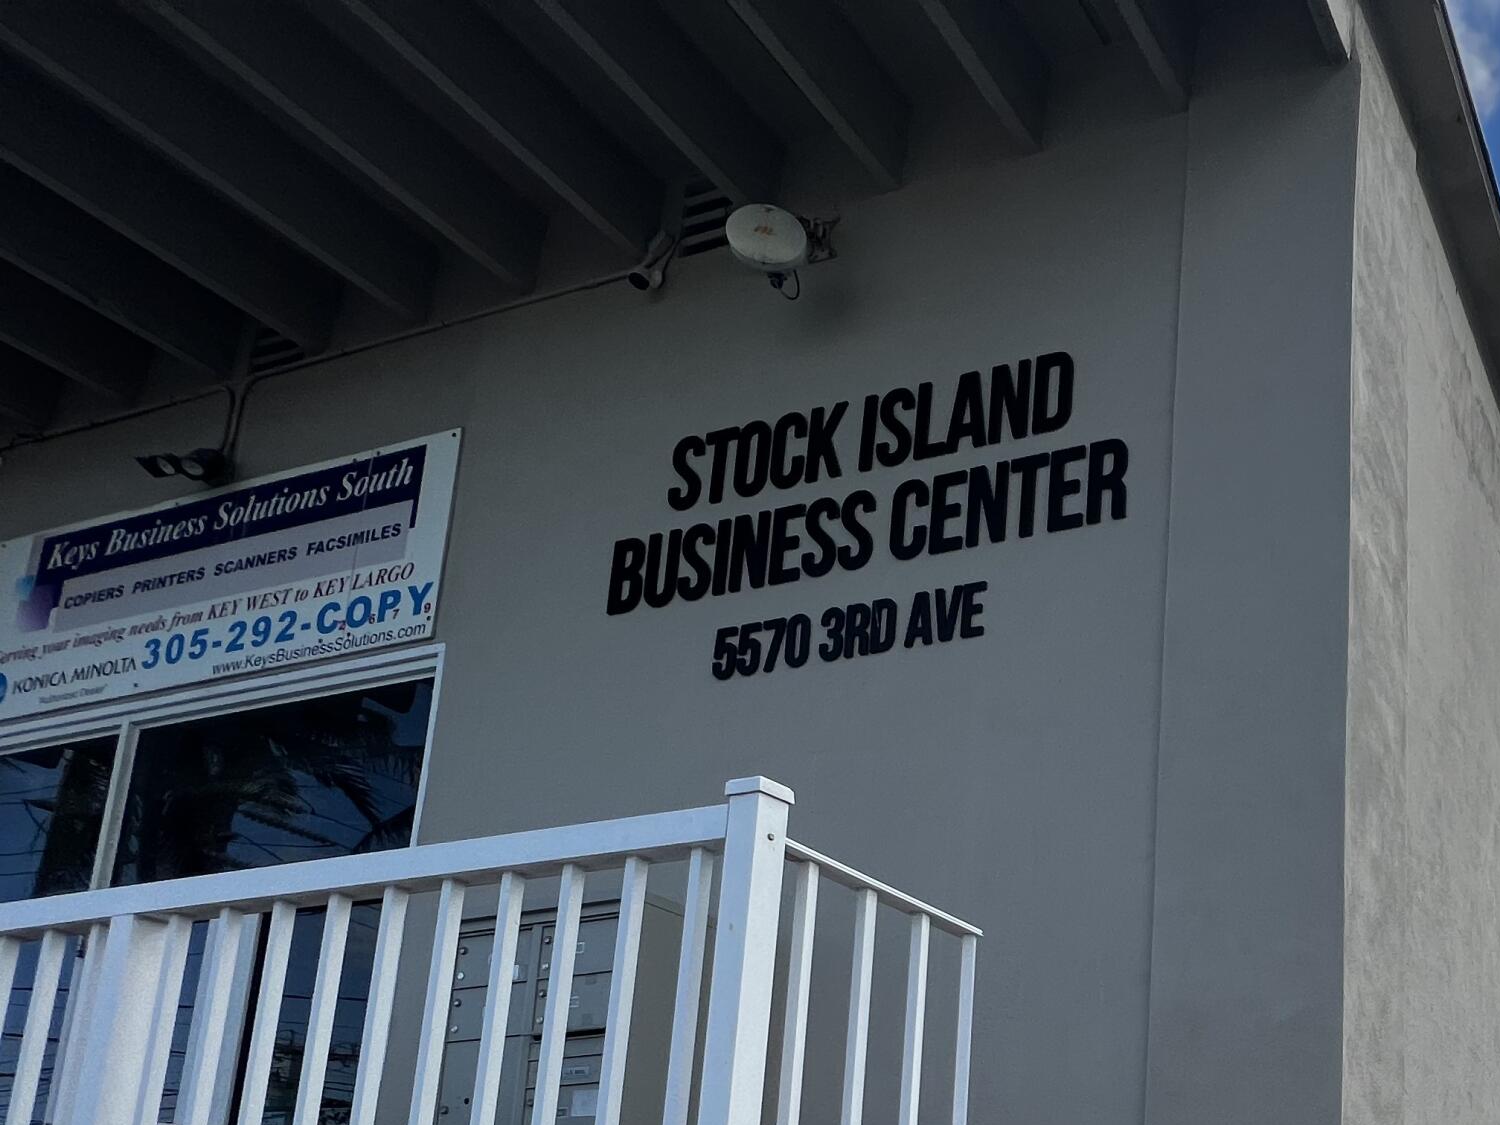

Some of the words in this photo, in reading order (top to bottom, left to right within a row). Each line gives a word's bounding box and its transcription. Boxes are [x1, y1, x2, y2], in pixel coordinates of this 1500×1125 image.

[667, 400, 849, 511] STOCK
[857, 351, 1075, 473] ISLAND
[46, 540, 100, 570] Keys
[104, 515, 208, 557] Business
[213, 485, 330, 531] Solutions
[336, 458, 414, 501] South
[606, 490, 877, 616] BUSINESS
[888, 438, 1129, 561] CENTER
[0, 646, 38, 664] erving
[73, 626, 126, 648] imaging
[128, 615, 167, 636] needs
[167, 611, 203, 633] from
[207, 598, 240, 621] KEY
[246, 589, 295, 611] WEST
[295, 588, 308, 602] to
[313, 577, 352, 599] KEY
[352, 562, 415, 590] LARGO
[63, 585, 124, 610] COPIERS
[132, 567, 205, 594] PRINTERS
[213, 546, 298, 577] SCANNERS
[306, 523, 402, 556] FACSIMILES
[423, 602, 431, 614] 9
[142, 581, 435, 670] 305-292-COPY
[212, 622, 426, 676] www.KeysBusinessSolutions.com
[711, 613, 812, 681] 5570
[818, 598, 898, 664] 3RD
[904, 580, 988, 649] AVE
[13, 668, 67, 695] KONICA
[70, 657, 137, 684] MINOLTA
